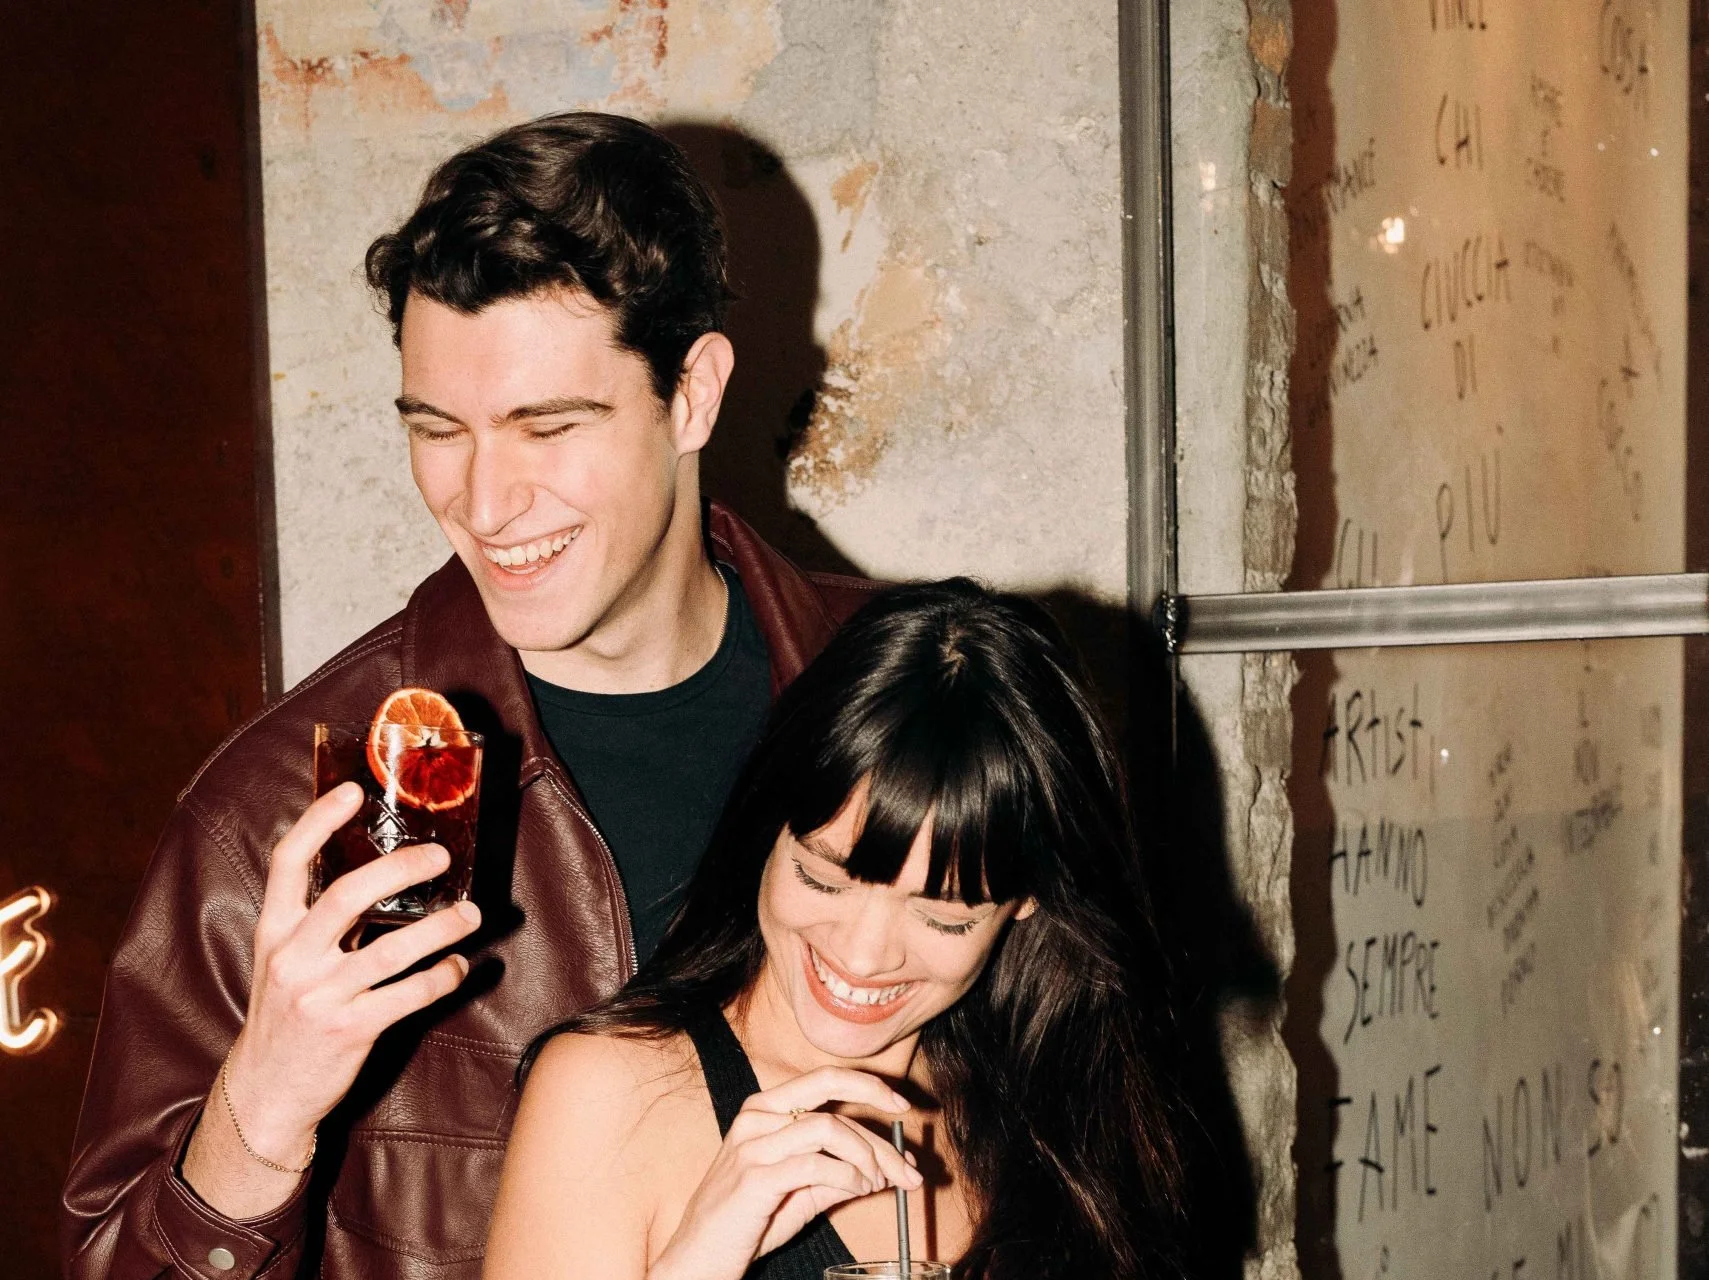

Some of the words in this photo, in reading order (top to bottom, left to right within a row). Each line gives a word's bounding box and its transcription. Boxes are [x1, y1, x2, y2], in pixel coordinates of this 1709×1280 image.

[1435, 92, 1484, 171] CHI
[1420, 234, 1511, 331] CIUCCIA
[1453, 334, 1478, 400] DI
[1328, 818, 1428, 908] HANNO
[1343, 931, 1440, 1045] SEMPRE
[1483, 1062, 1563, 1213] NON
